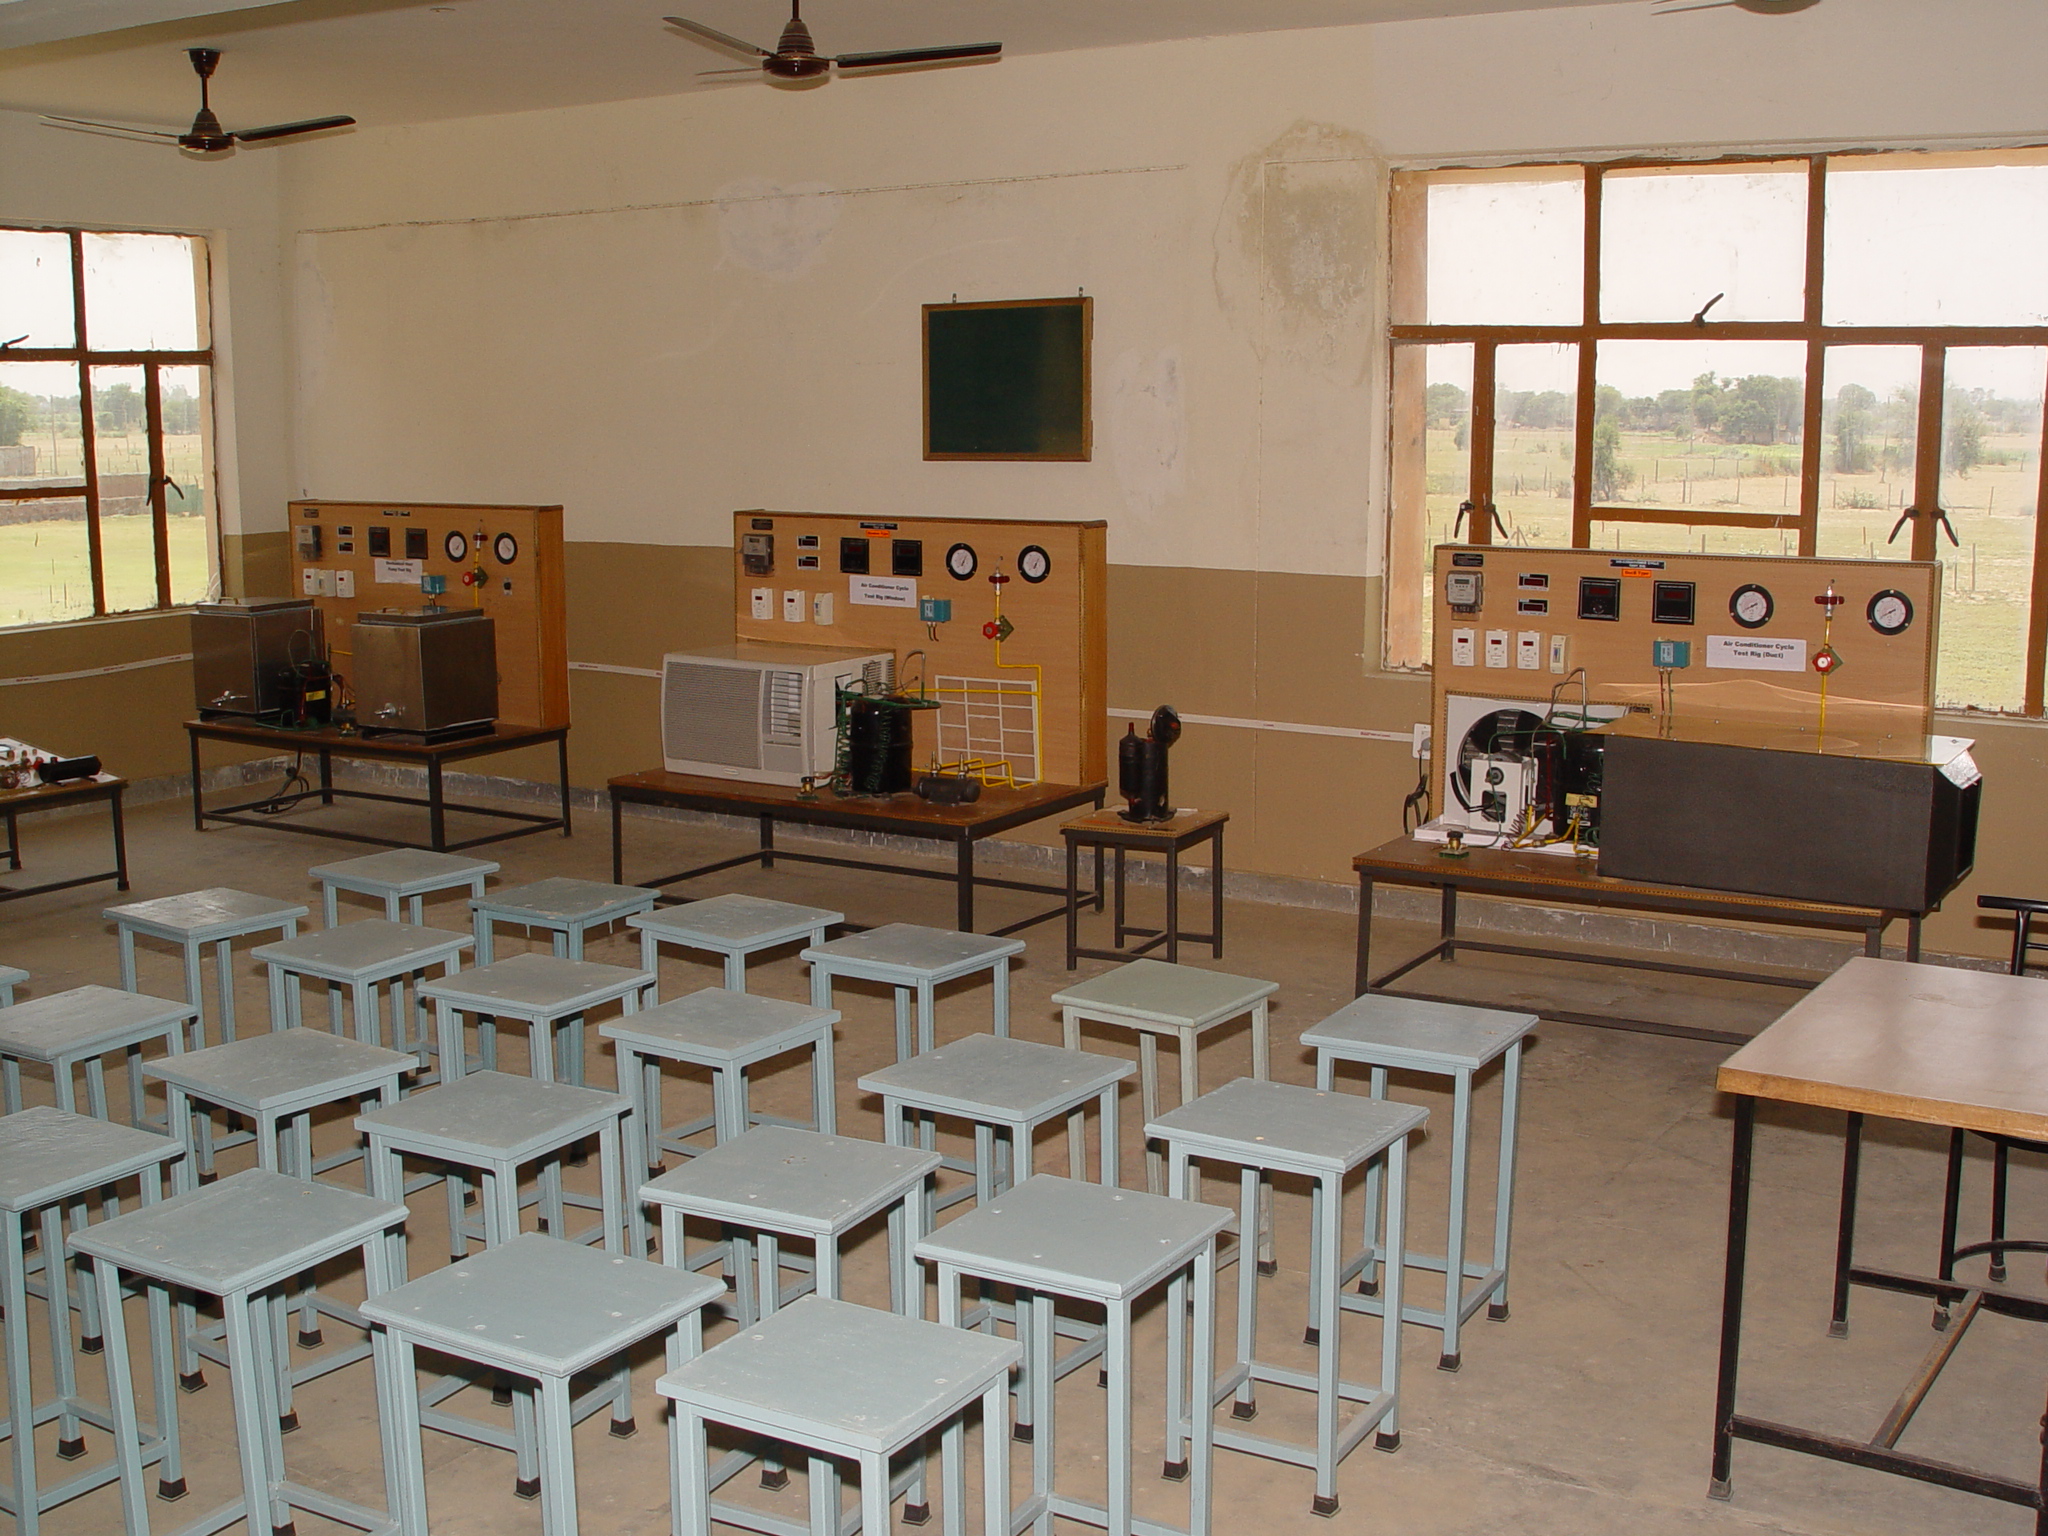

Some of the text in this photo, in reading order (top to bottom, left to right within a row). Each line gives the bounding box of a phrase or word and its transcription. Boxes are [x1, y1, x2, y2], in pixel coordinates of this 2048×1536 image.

[1734, 641, 1774, 649] Conditioner
[1775, 643, 1795, 651] Cycle
[1750, 650, 1761, 658] Rig
[1762, 651, 1784, 659] (Duct)
